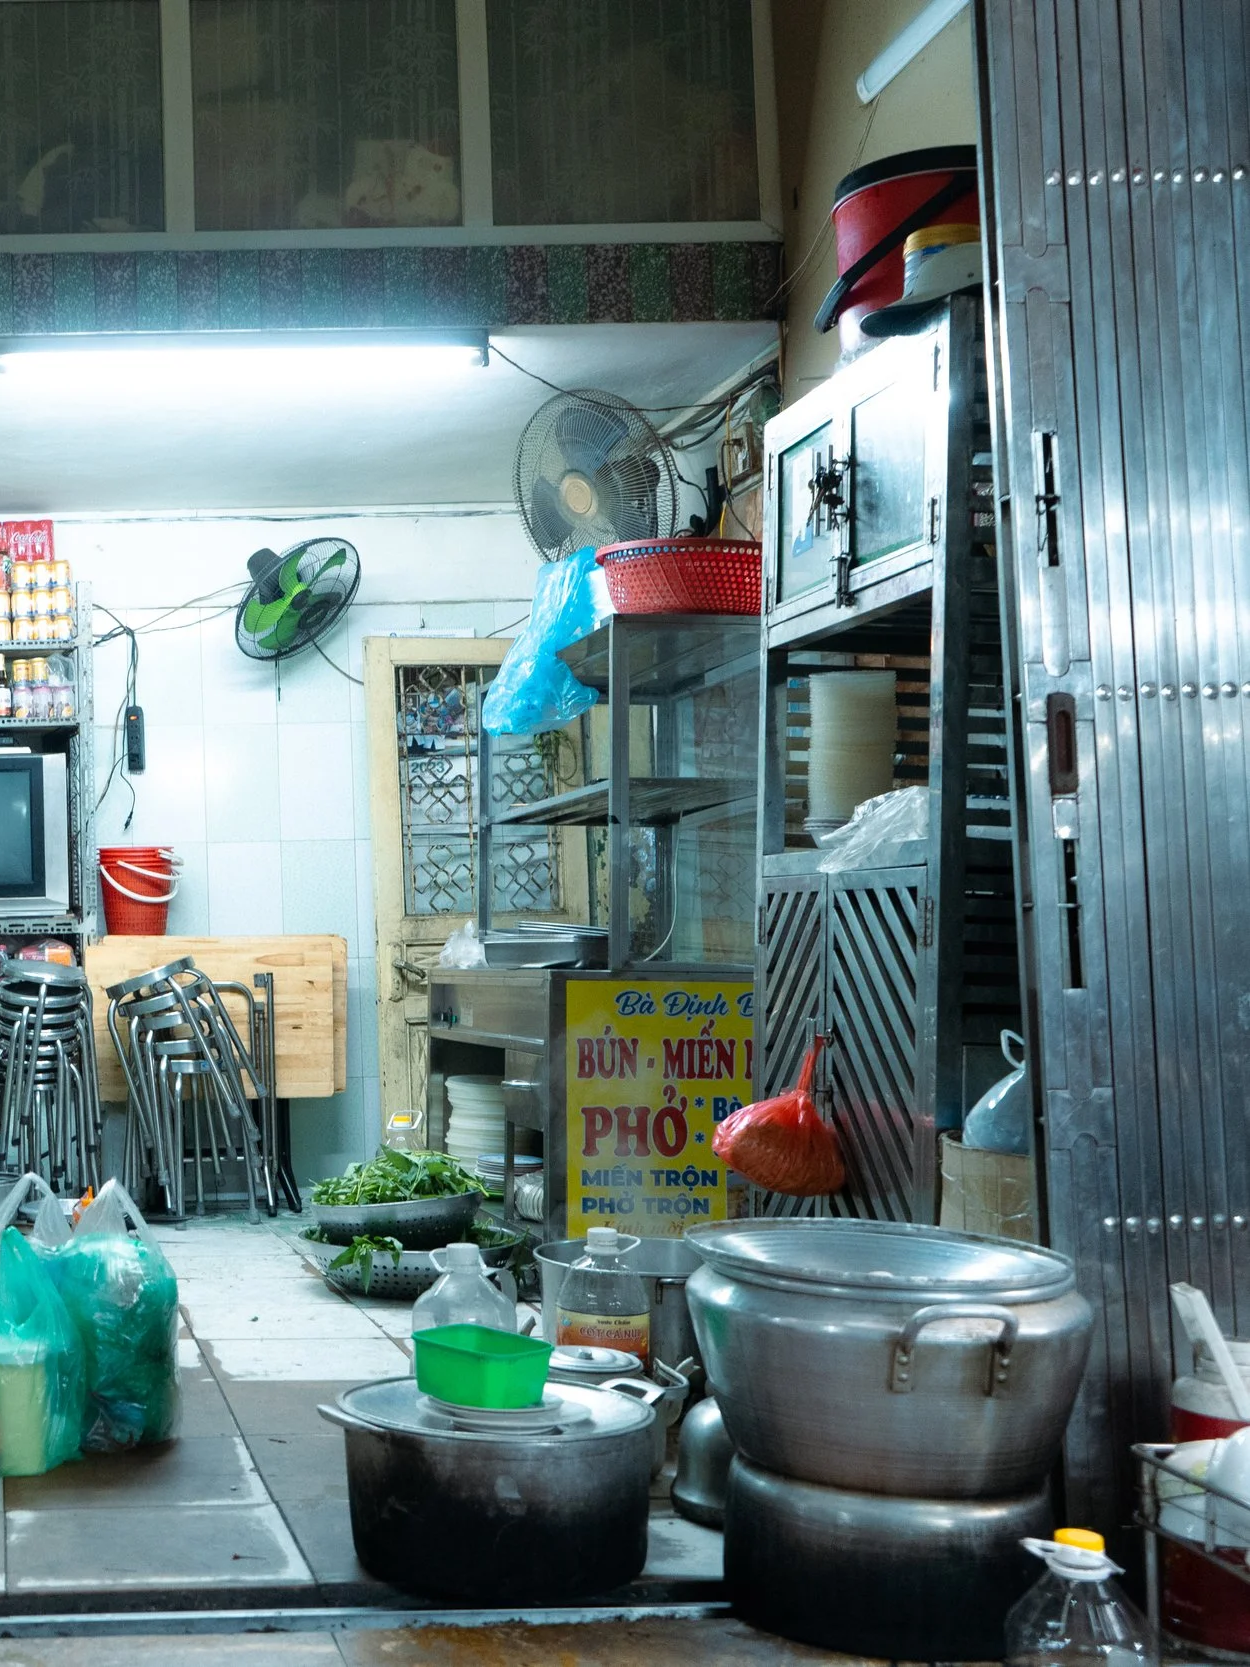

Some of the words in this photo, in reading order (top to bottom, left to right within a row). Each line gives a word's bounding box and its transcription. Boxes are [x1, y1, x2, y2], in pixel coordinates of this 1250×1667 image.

[411, 761, 445, 774] 2023
[615, 990, 656, 1016] Bà
[662, 990, 729, 1022] Định
[577, 1025, 640, 1079] BÚN
[662, 1018, 736, 1080] MIẾN
[580, 1084, 689, 1158] PHỞ
[581, 1163, 643, 1187] MIẾN
[649, 1165, 718, 1192] TRỘN
[581, 1191, 635, 1215] PHỞ
[641, 1192, 710, 1219] TRỘN
